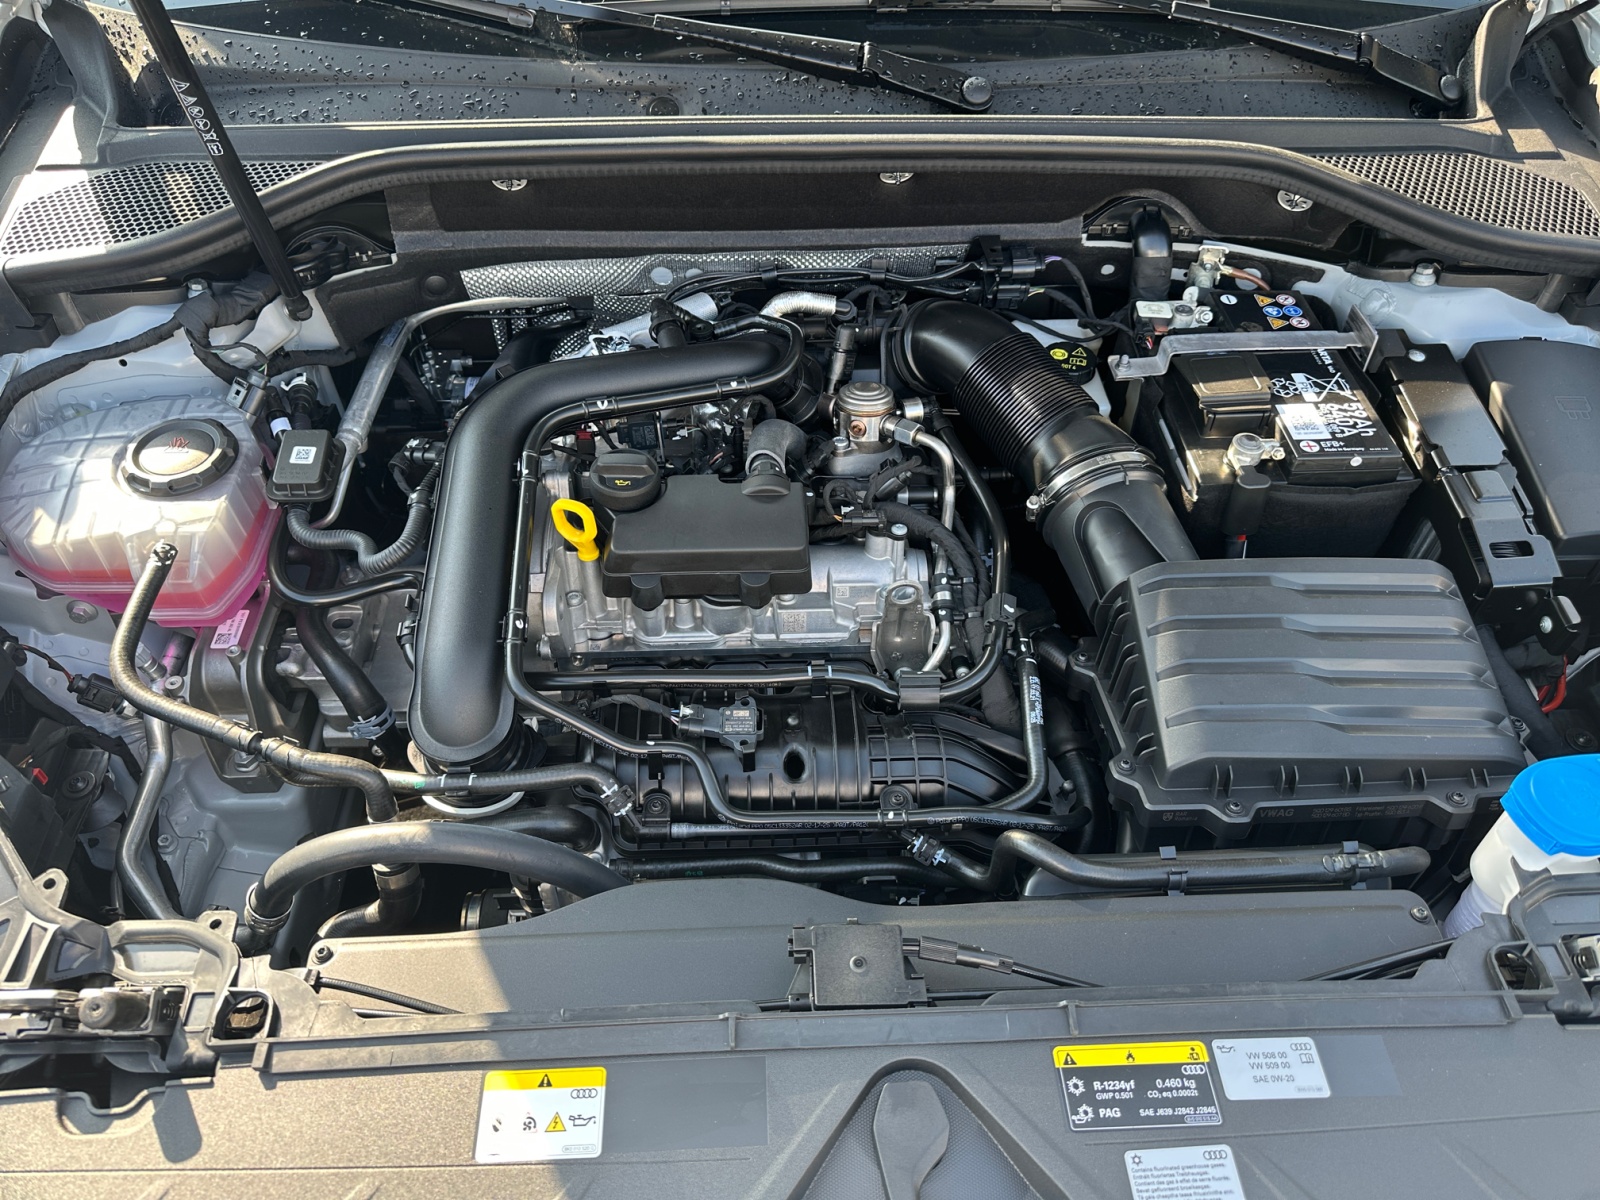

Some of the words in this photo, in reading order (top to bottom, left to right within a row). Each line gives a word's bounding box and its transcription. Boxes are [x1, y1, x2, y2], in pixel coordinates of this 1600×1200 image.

[1317, 348, 1333, 364] ARTA
[1326, 403, 1359, 436] 640A
[1343, 403, 1377, 436] 59Ah
[1260, 808, 1294, 818] VWAG
[1156, 1078, 1182, 1088] 0.460
[1183, 1078, 1196, 1089] kg
[1253, 1075, 1269, 1083] SAE
[1271, 1074, 1295, 1082] 0W-20
[1093, 1080, 1135, 1091] R-1234yf
[1096, 1092, 1114, 1100] GWP
[1115, 1091, 1133, 1099] 0.501
[1099, 1107, 1121, 1118] PAG
[1139, 1108, 1155, 1116] SAE
[1156, 1108, 1173, 1116] J639
[1174, 1107, 1194, 1115] J2842
[1196, 1106, 1216, 1114] J2845
